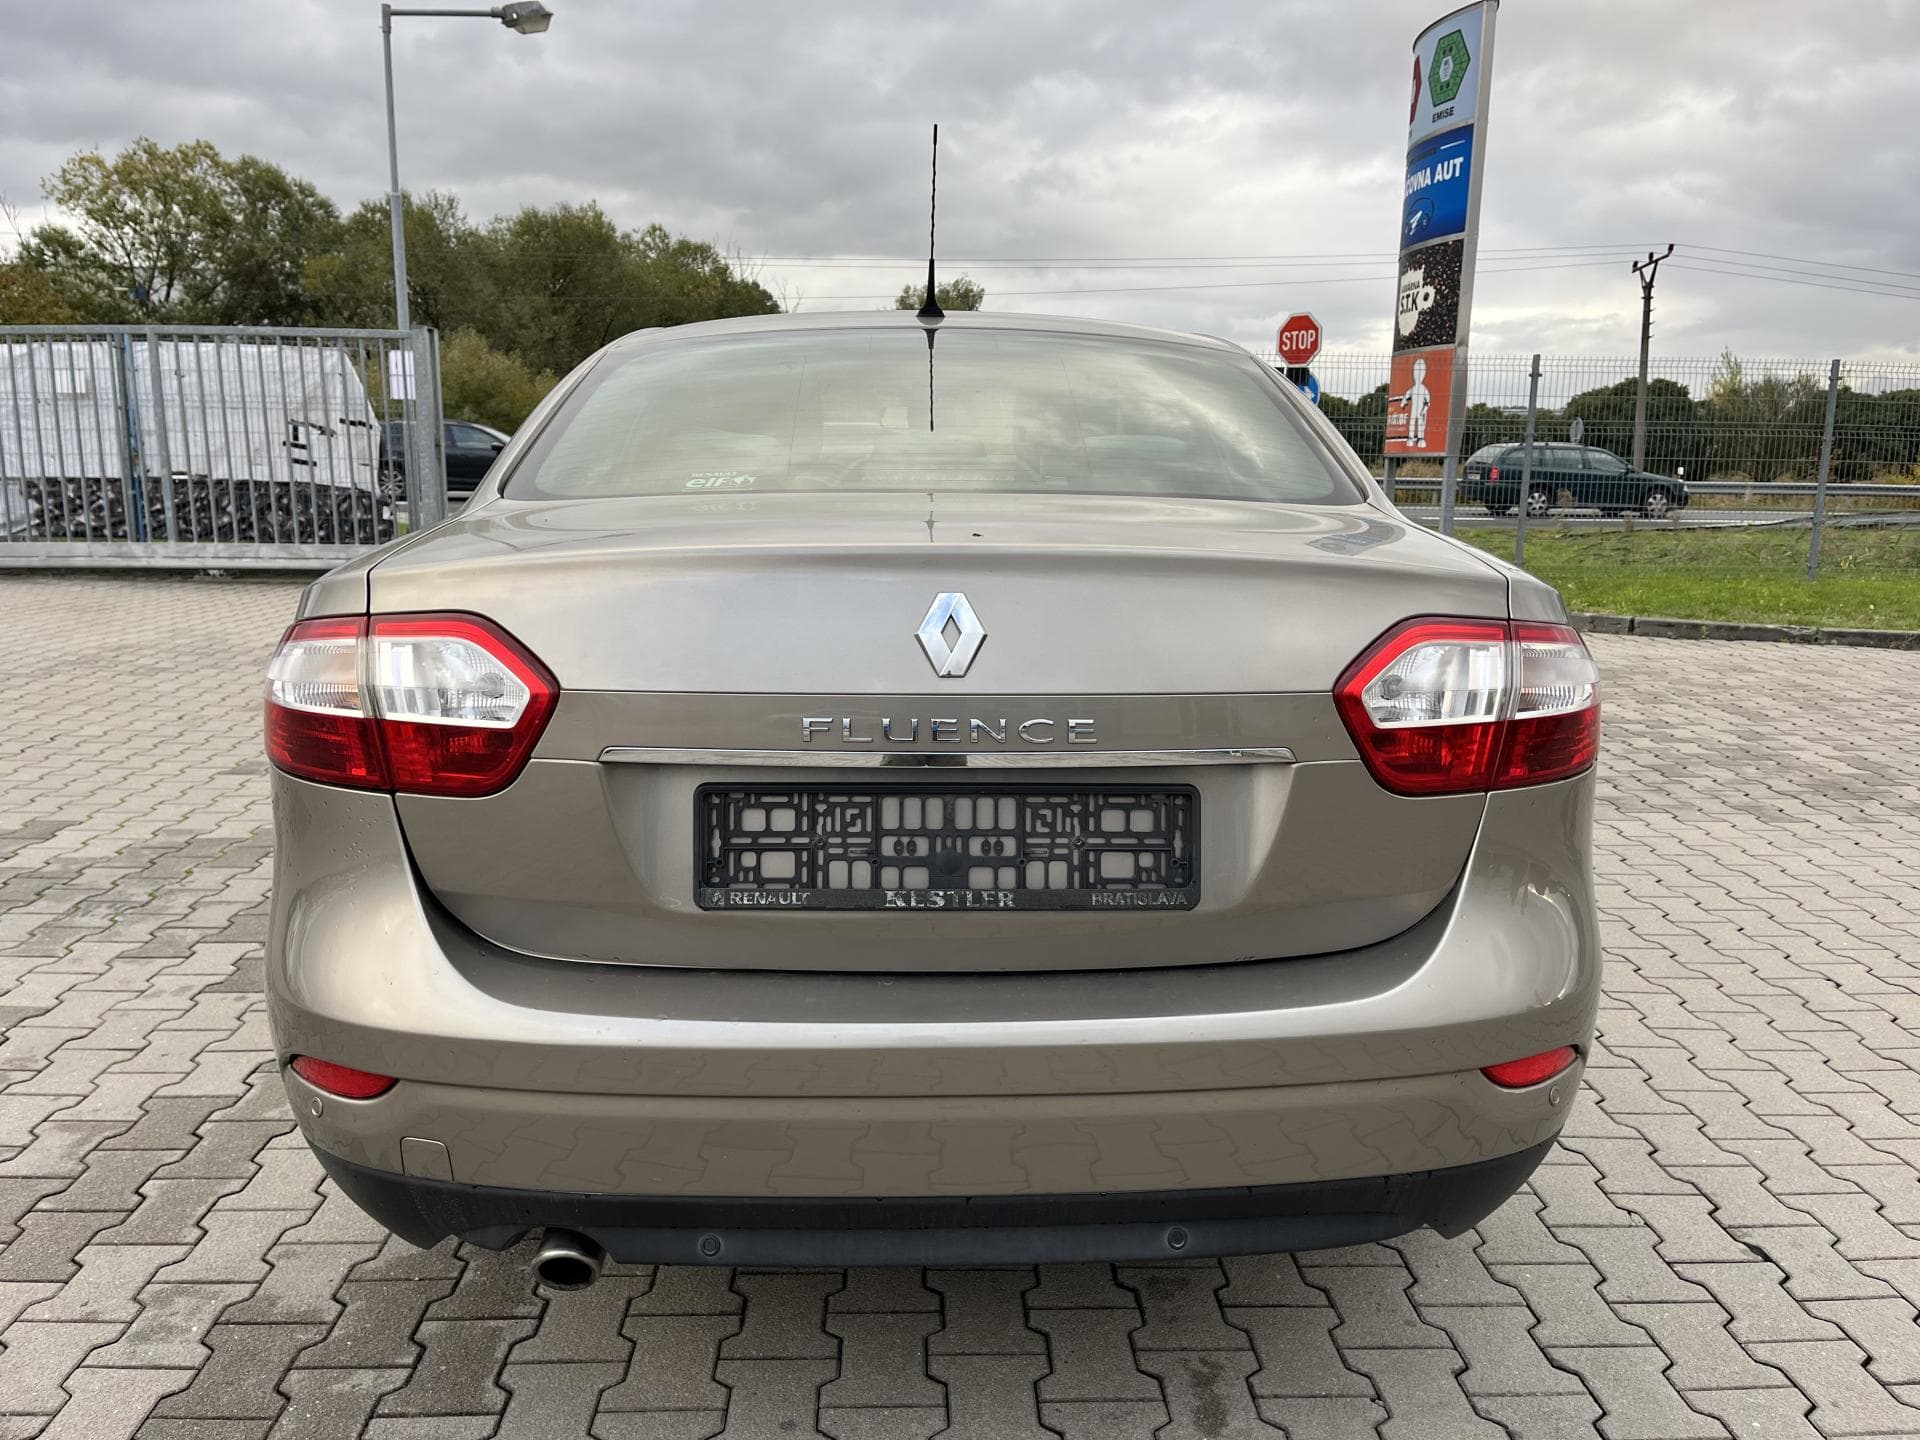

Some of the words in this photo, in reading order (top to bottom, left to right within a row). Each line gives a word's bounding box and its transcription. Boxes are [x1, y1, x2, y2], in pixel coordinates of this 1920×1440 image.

[1432, 106, 1455, 123] EMISE
[1434, 156, 1464, 184] AUT
[1281, 329, 1316, 351] STOP
[801, 717, 1098, 744] FLUENCE
[729, 890, 811, 905] RENAULT
[884, 890, 1016, 908] KESTLER
[1091, 891, 1188, 906] BRATISLAVA
